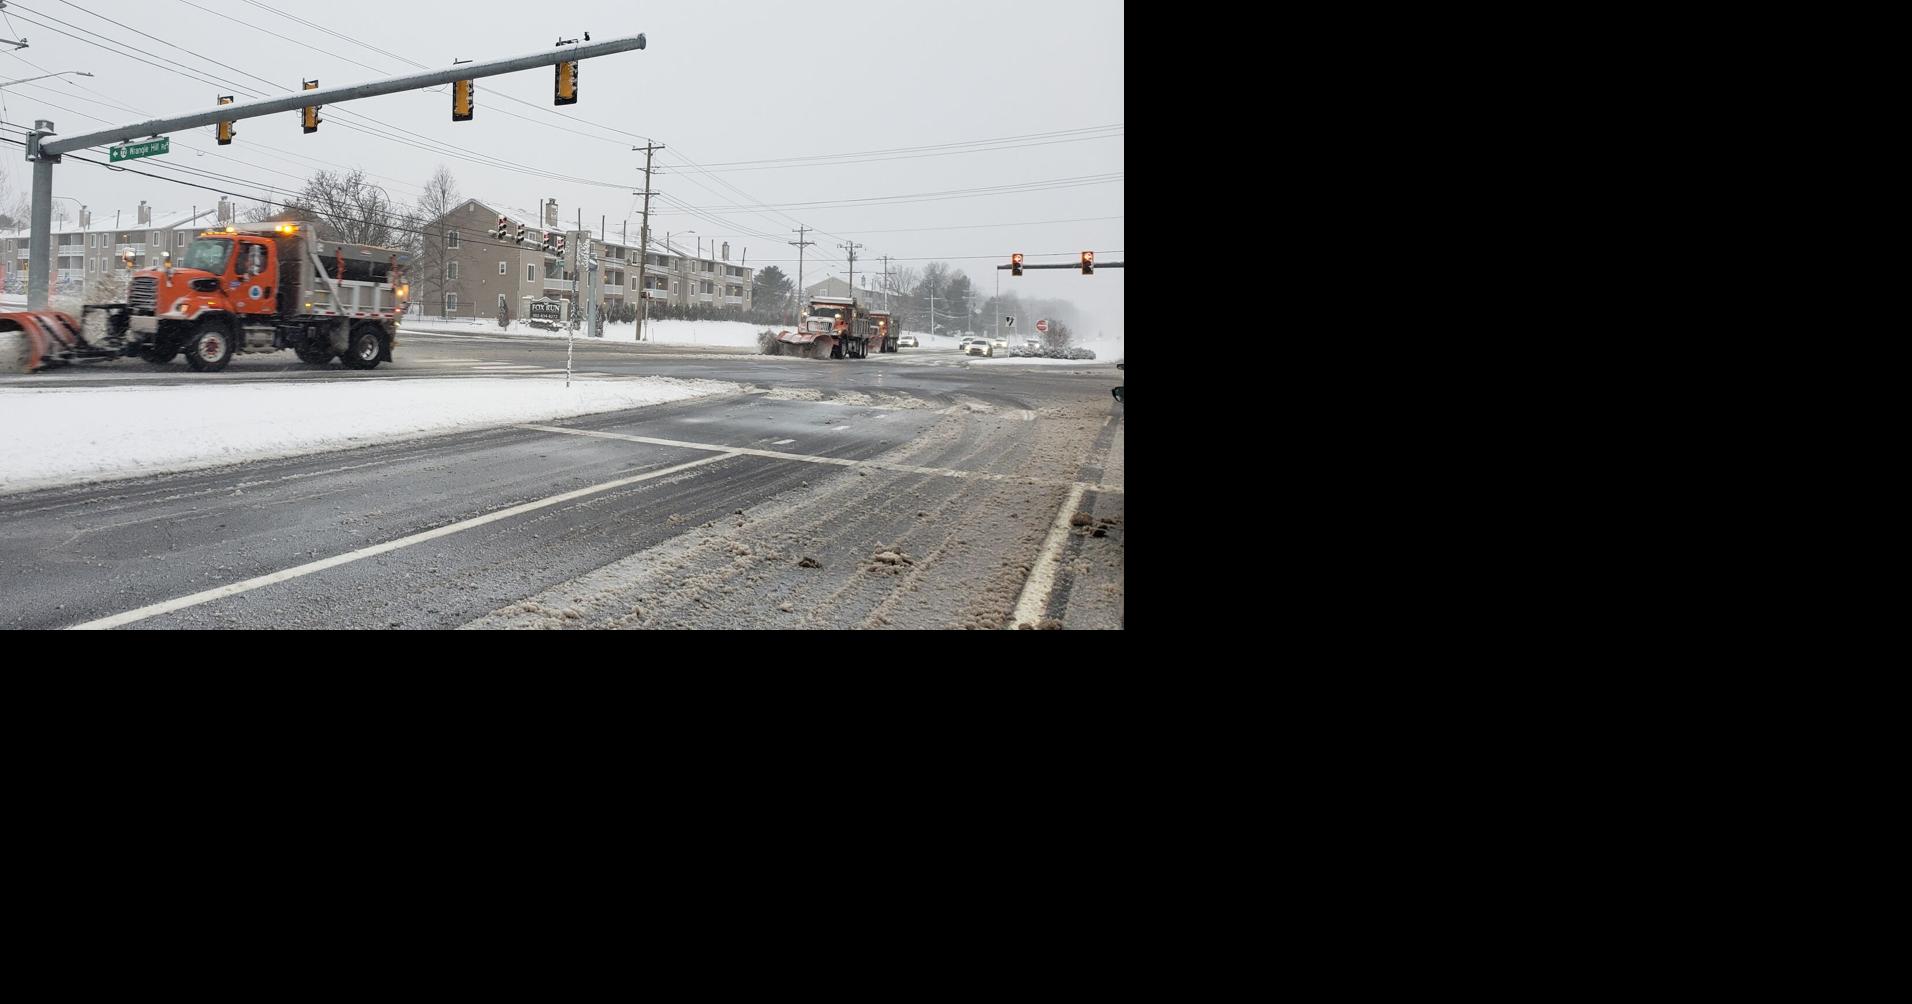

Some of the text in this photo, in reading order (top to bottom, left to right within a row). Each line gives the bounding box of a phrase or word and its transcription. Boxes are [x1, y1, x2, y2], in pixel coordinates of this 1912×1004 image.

[129, 145, 149, 156] Wrangle
[151, 142, 159, 152] Hill
[531, 303, 545, 311] FOX
